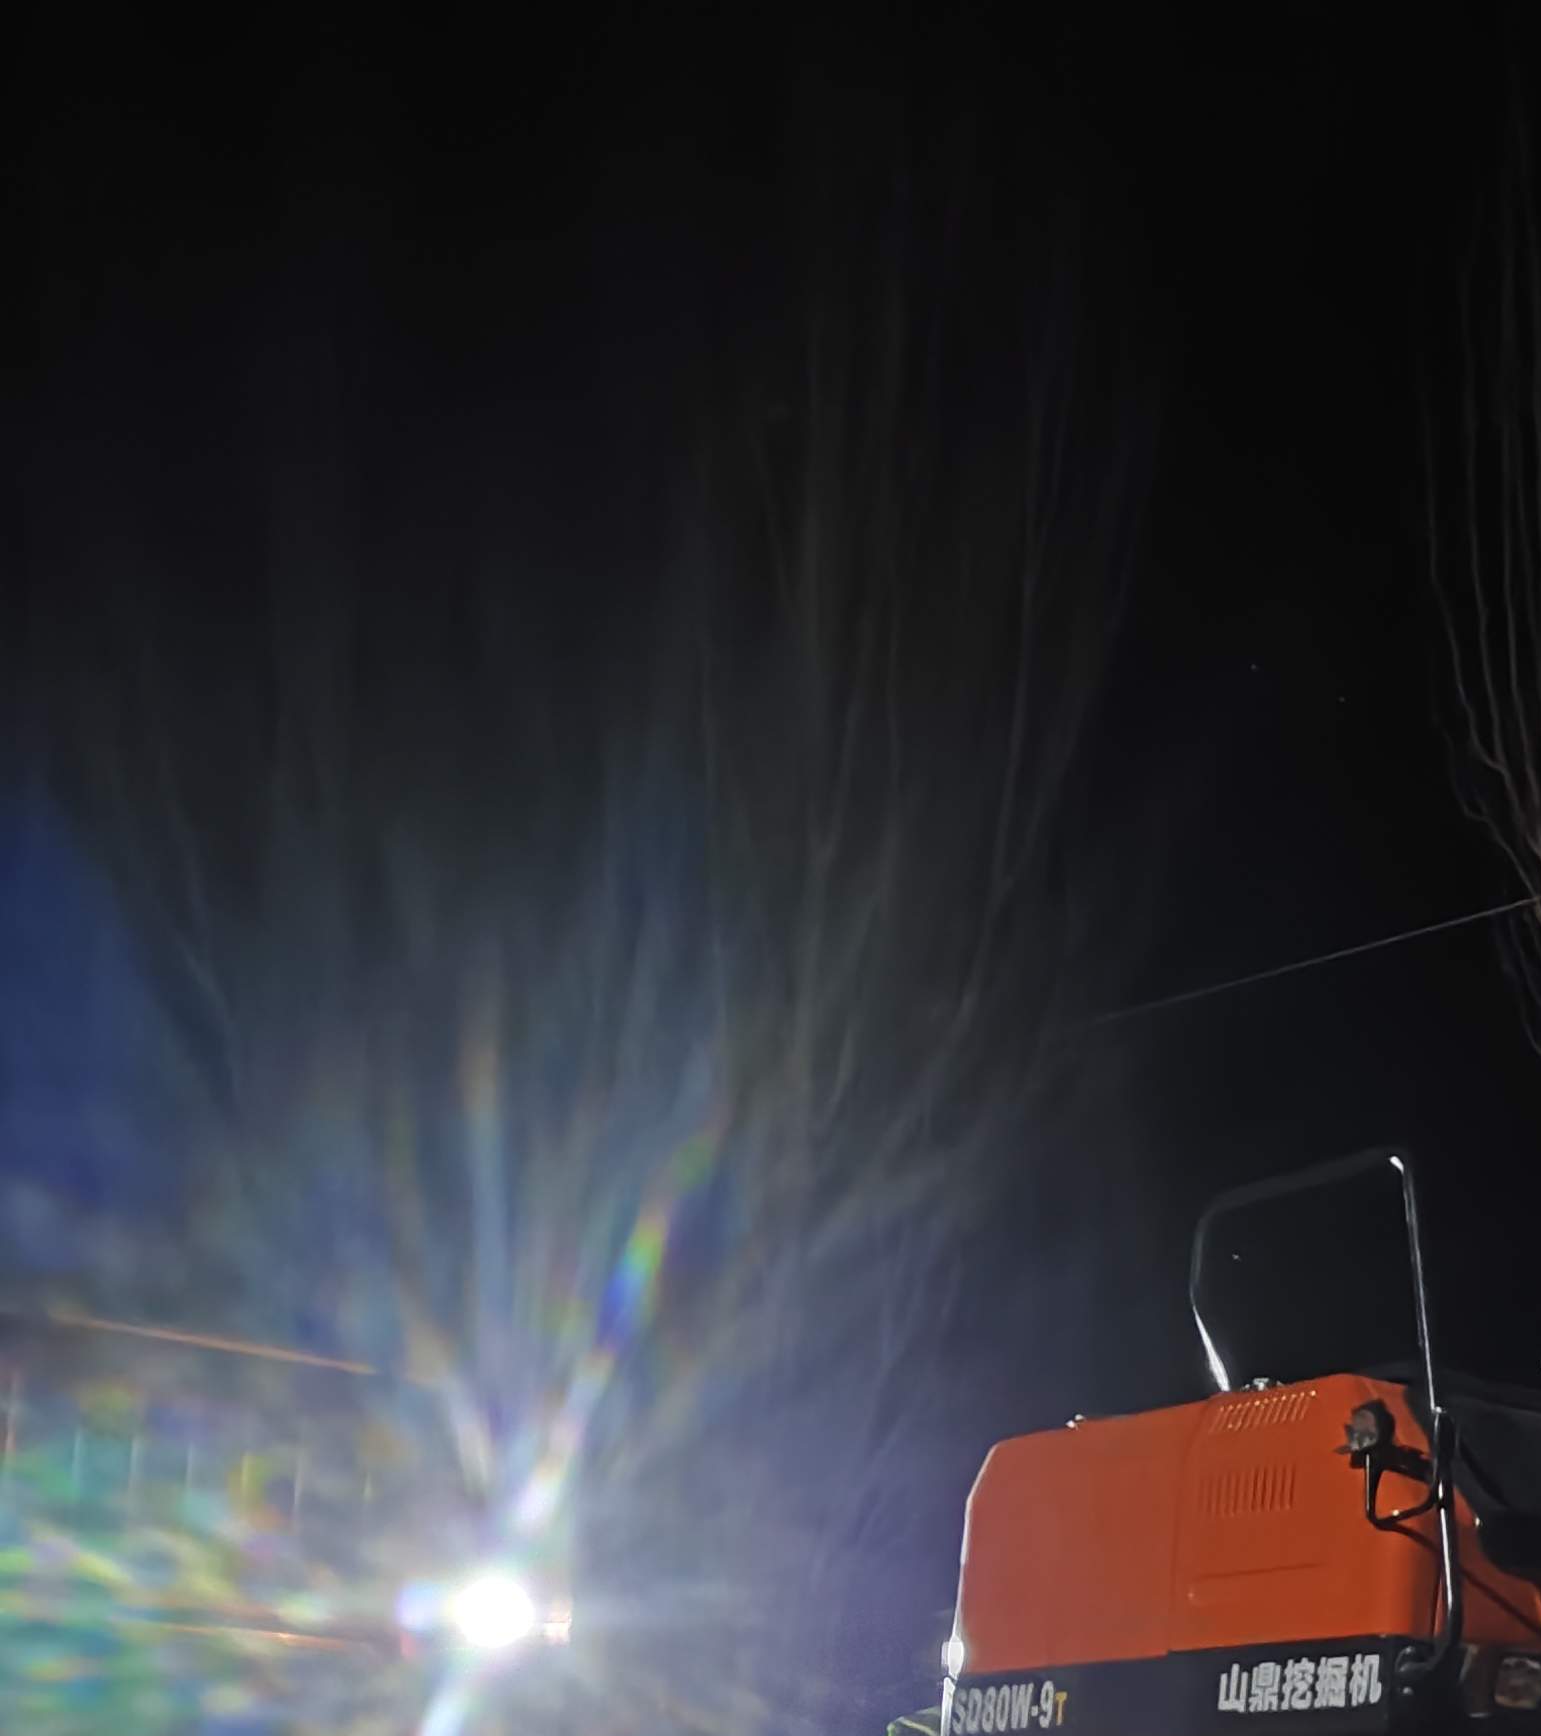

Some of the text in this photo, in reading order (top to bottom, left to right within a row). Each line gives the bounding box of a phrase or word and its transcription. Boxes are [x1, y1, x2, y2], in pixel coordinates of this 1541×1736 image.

[952, 1680, 1068, 1735] SD80W-9T
[1217, 1653, 1382, 1713] 山鼎挖掘机
